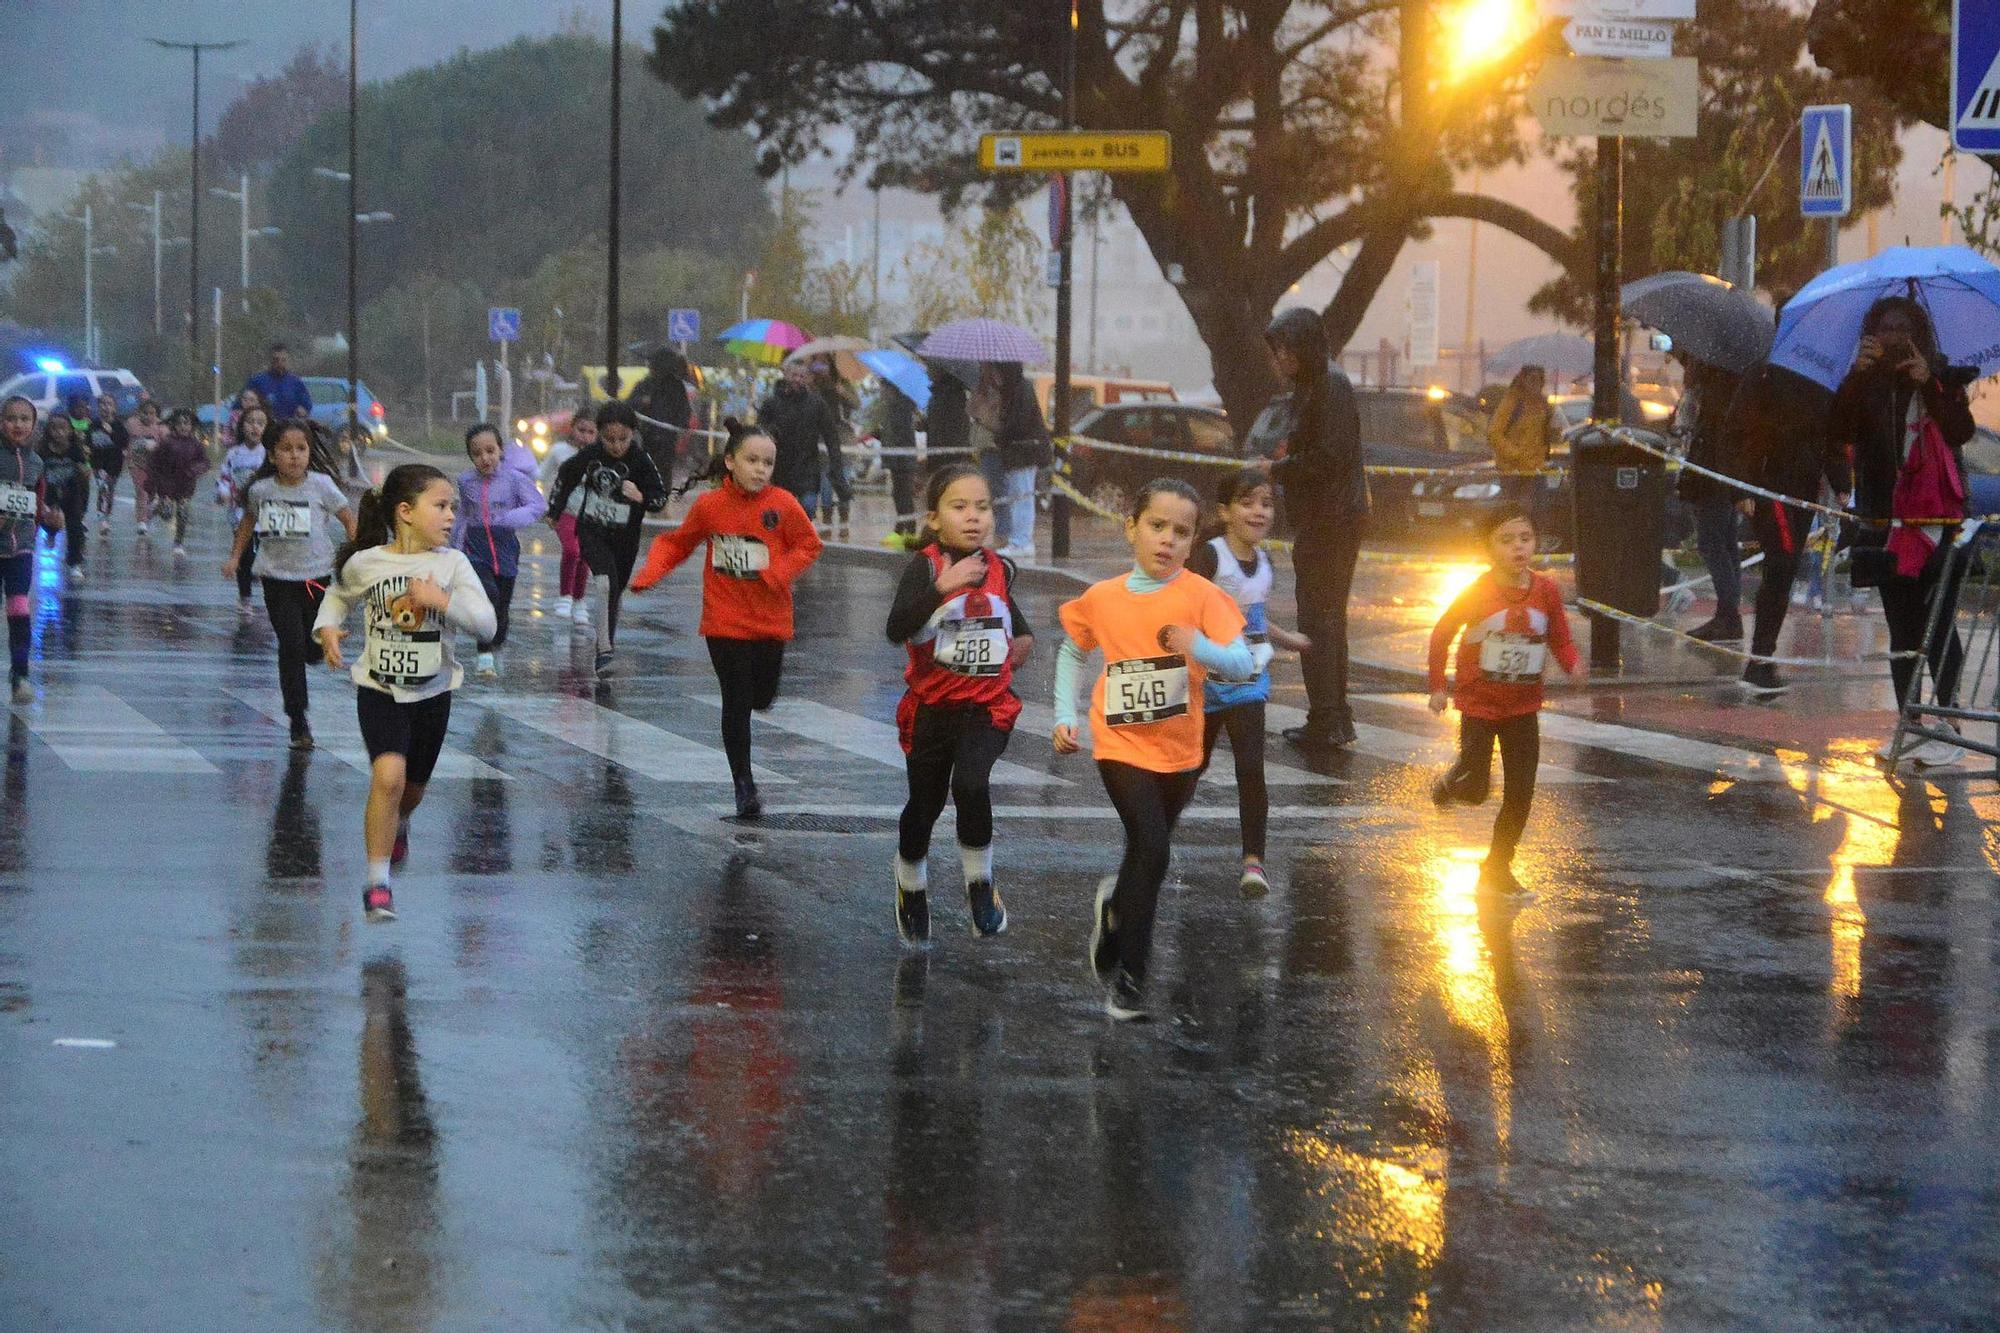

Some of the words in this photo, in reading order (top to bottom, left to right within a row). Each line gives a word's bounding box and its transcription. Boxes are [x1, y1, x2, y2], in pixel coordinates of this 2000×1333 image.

[1576, 25, 1603, 38] PAN
[1607, 26, 1616, 39] E
[1547, 90, 1666, 119] nordés
[1080, 147, 1096, 157] de
[1102, 142, 1140, 157] BUS
[268, 511, 296, 530] 570
[378, 648, 419, 675] 535
[952, 638, 990, 663] 568
[1121, 679, 1166, 711] 546
